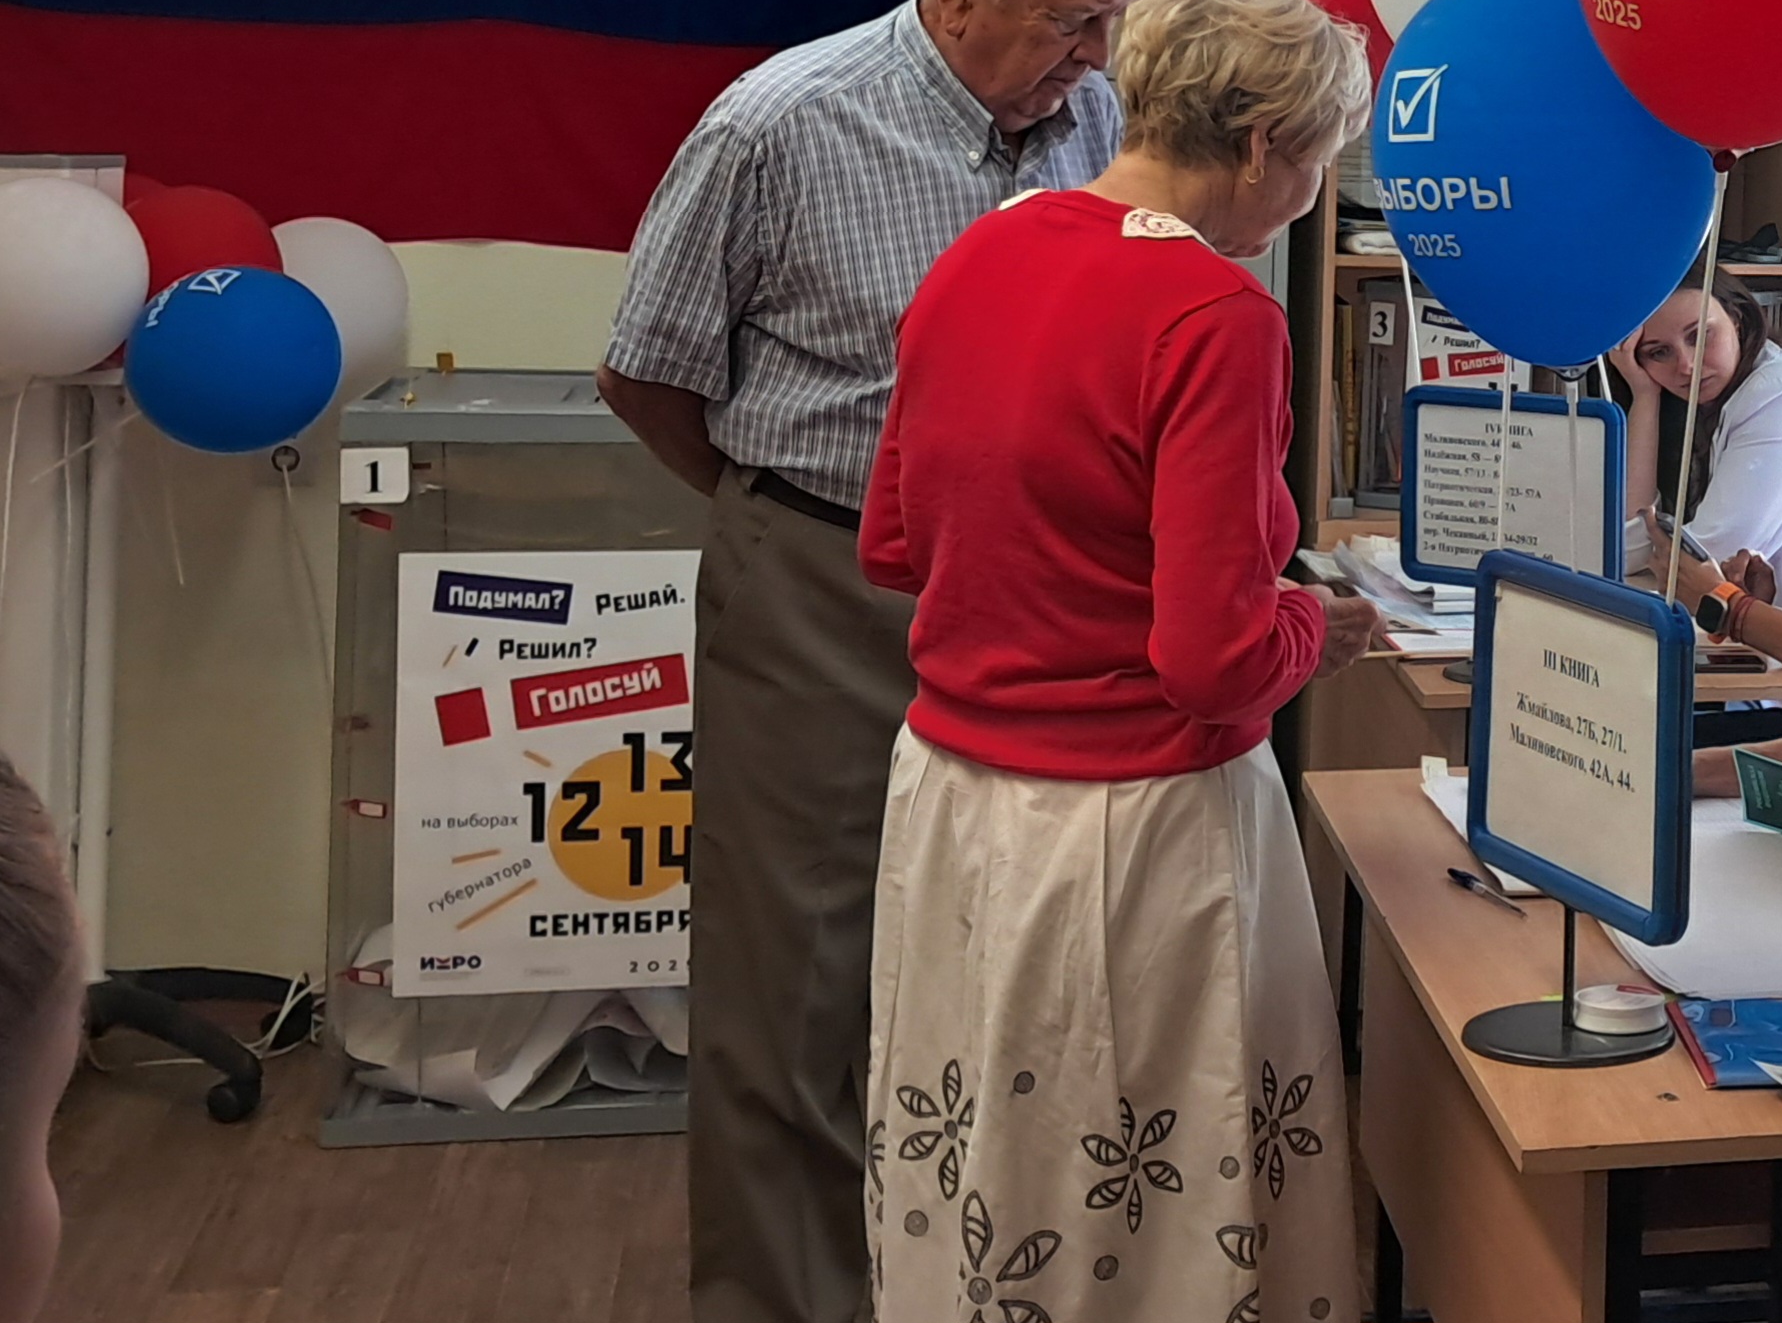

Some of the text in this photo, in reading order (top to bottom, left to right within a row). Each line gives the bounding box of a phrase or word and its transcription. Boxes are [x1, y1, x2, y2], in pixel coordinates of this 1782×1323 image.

[1408, 234, 1462, 257] 2025
[1372, 311, 1388, 338] 3
[365, 460, 382, 494] 1
[1560, 655, 1600, 688] КНИГА
[1516, 691, 1627, 754] Жмайлова, 27Б, 27/1.
[622, 731, 693, 792] 13
[1509, 723, 1635, 793] Малиновского, 42А, 44.
[421, 813, 518, 830] на выборах
[523, 781, 601, 843] 12
[620, 824, 692, 887] 14
[427, 856, 533, 914] губернатора
[529, 910, 691, 938] СЕНТЯБРЯ
[629, 959, 691, 974] 202
